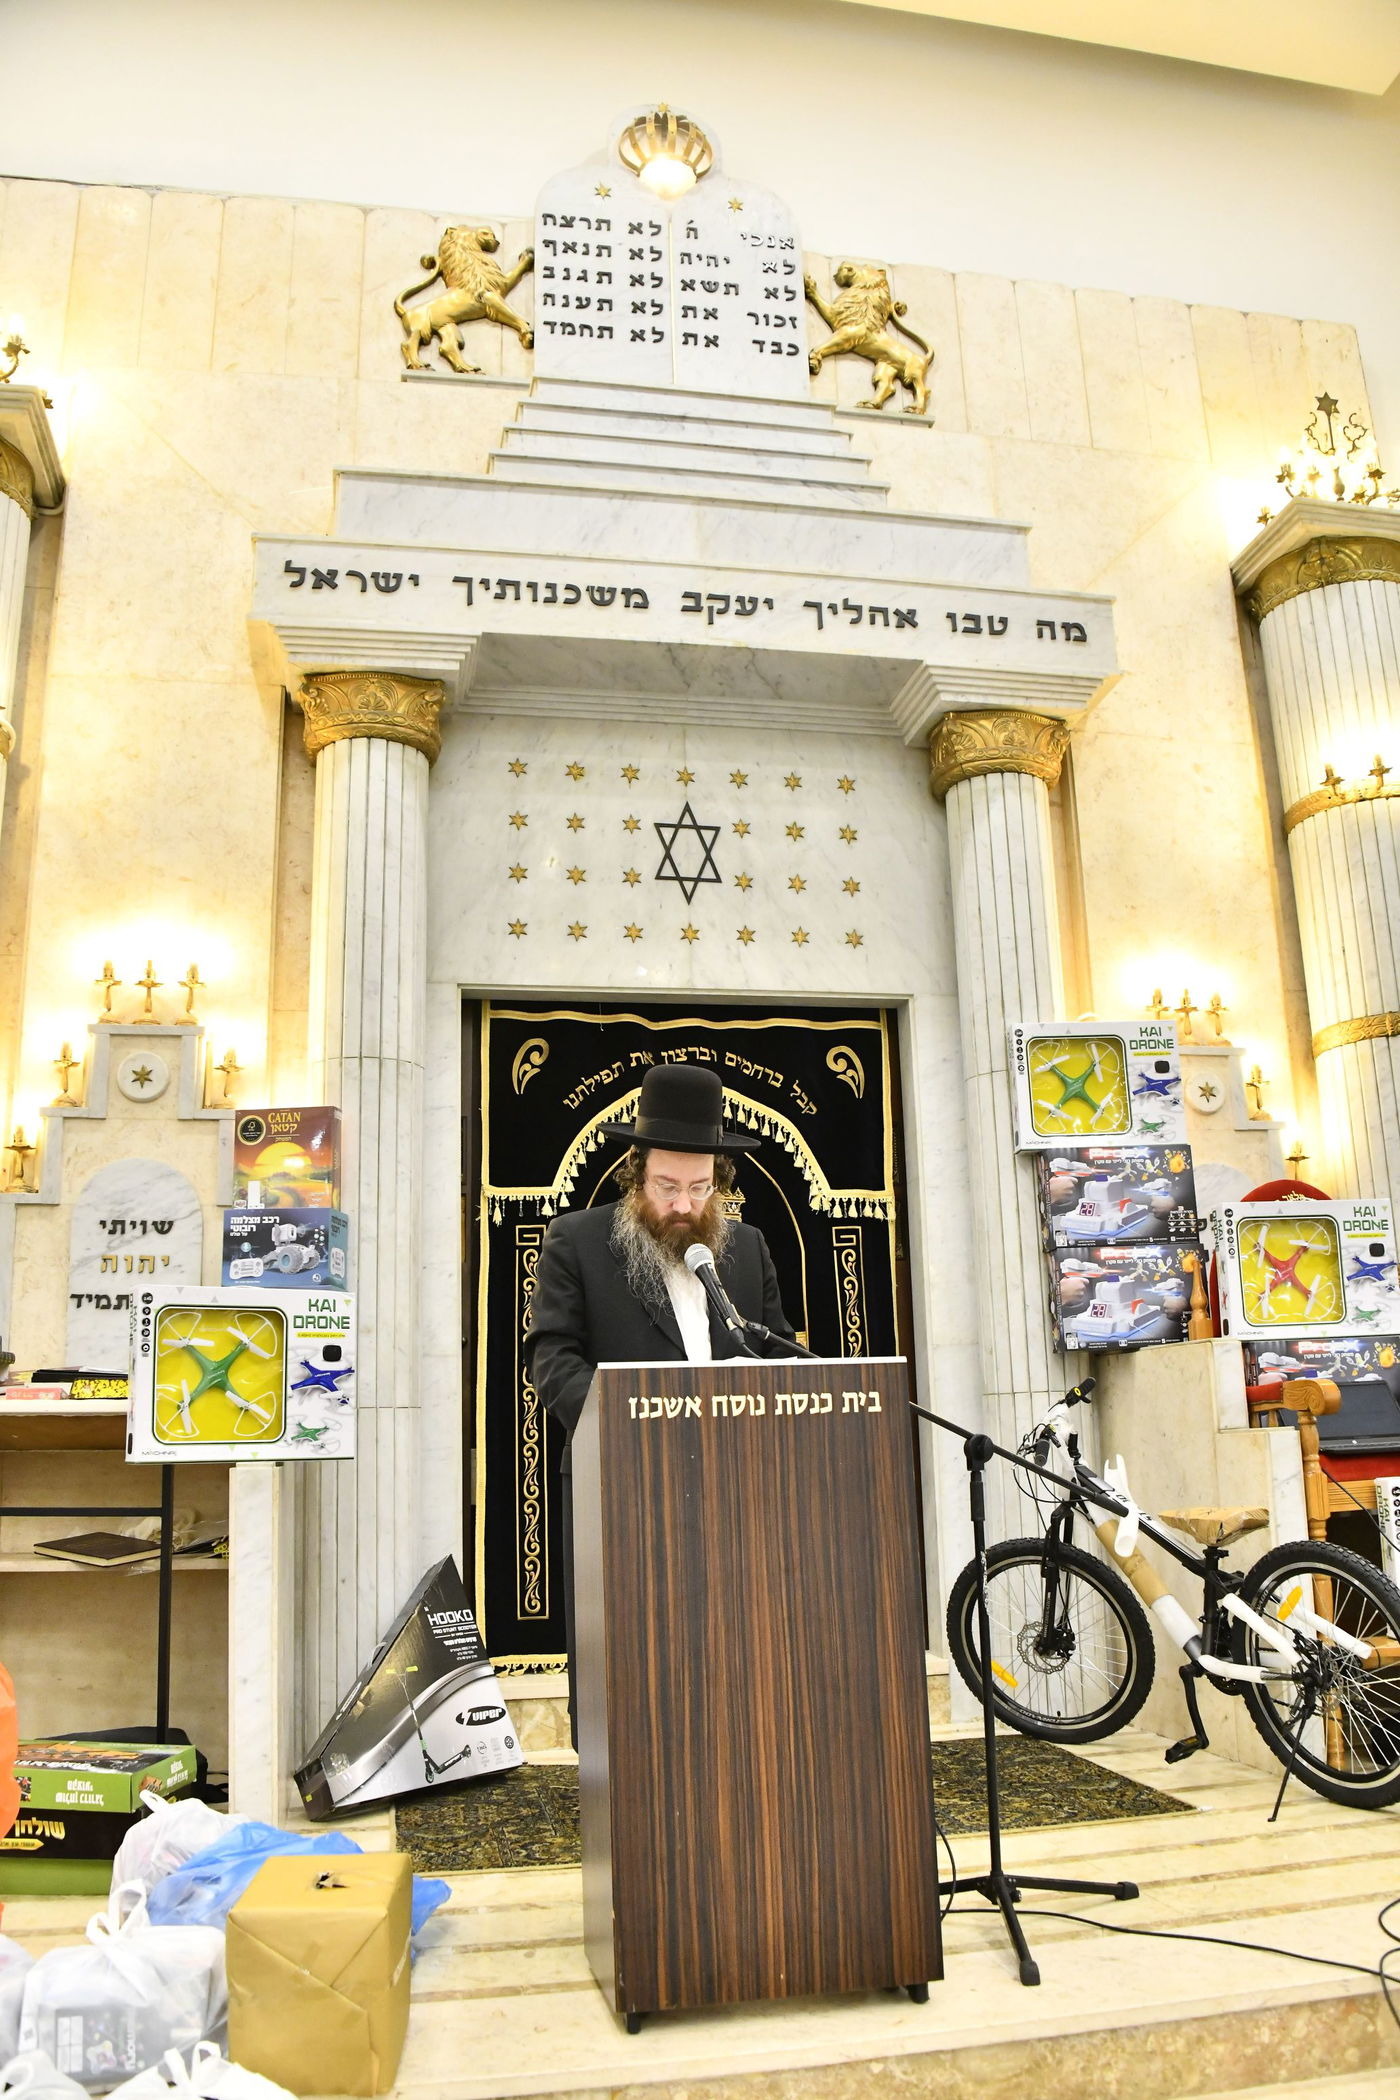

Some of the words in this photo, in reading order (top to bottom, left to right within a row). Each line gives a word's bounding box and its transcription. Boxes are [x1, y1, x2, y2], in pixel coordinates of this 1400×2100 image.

[542, 213, 611, 232] תרצח
[628, 220, 662, 237] לא
[542, 238, 612, 258] תנאף
[740, 231, 795, 250] אנכי
[628, 246, 663, 263] לא
[680, 252, 730, 268] יהיה
[543, 266, 613, 285] תגנב
[762, 259, 796, 275] לא
[629, 272, 663, 289] לא
[680, 277, 740, 296] תשא
[543, 293, 613, 312] תענה
[764, 285, 797, 302] לא
[631, 299, 664, 316] לא
[681, 305, 719, 320] את
[747, 311, 797, 329] זכור
[543, 320, 614, 340] תחמד
[630, 327, 665, 344] לא
[682, 331, 719, 348] את
[752, 338, 800, 357] כבד
[283, 559, 420, 594] ישראל
[452, 575, 650, 610] משכנותיך
[681, 590, 775, 626] יעקב
[803, 597, 919, 631] אהליך
[946, 611, 1009, 636] טבו
[1036, 619, 1088, 643] מה
[1139, 1027, 1162, 1037] KAI
[1129, 1038, 1175, 1050] DRONE
[630, 1050, 654, 1068] את
[661, 1045, 718, 1066] וברצון
[724, 1051, 785, 1088] ברחמים
[562, 1061, 625, 1112] תפילתנו
[790, 1080, 818, 1115] קבל
[268, 1111, 301, 1123] CATAN
[270, 1123, 298, 1136] קטאן
[230, 1216, 261, 1224] מצלמה
[262, 1216, 280, 1224] רכב
[1353, 1206, 1376, 1217] KAI
[99, 1219, 175, 1236] שויתי
[1343, 1219, 1389, 1232] DRONE
[100, 1255, 170, 1274] יהוה
[70, 1293, 130, 1310] תמיד
[308, 1298, 336, 1312] KAI
[293, 1315, 351, 1329] DRONE
[628, 1395, 702, 1419] אשכנז
[711, 1394, 766, 1417] נוסח
[775, 1392, 833, 1415] כנסת
[842, 1391, 882, 1413] בית
[427, 1609, 474, 1626] HOOKO
[15, 1817, 66, 1840] שולחן
